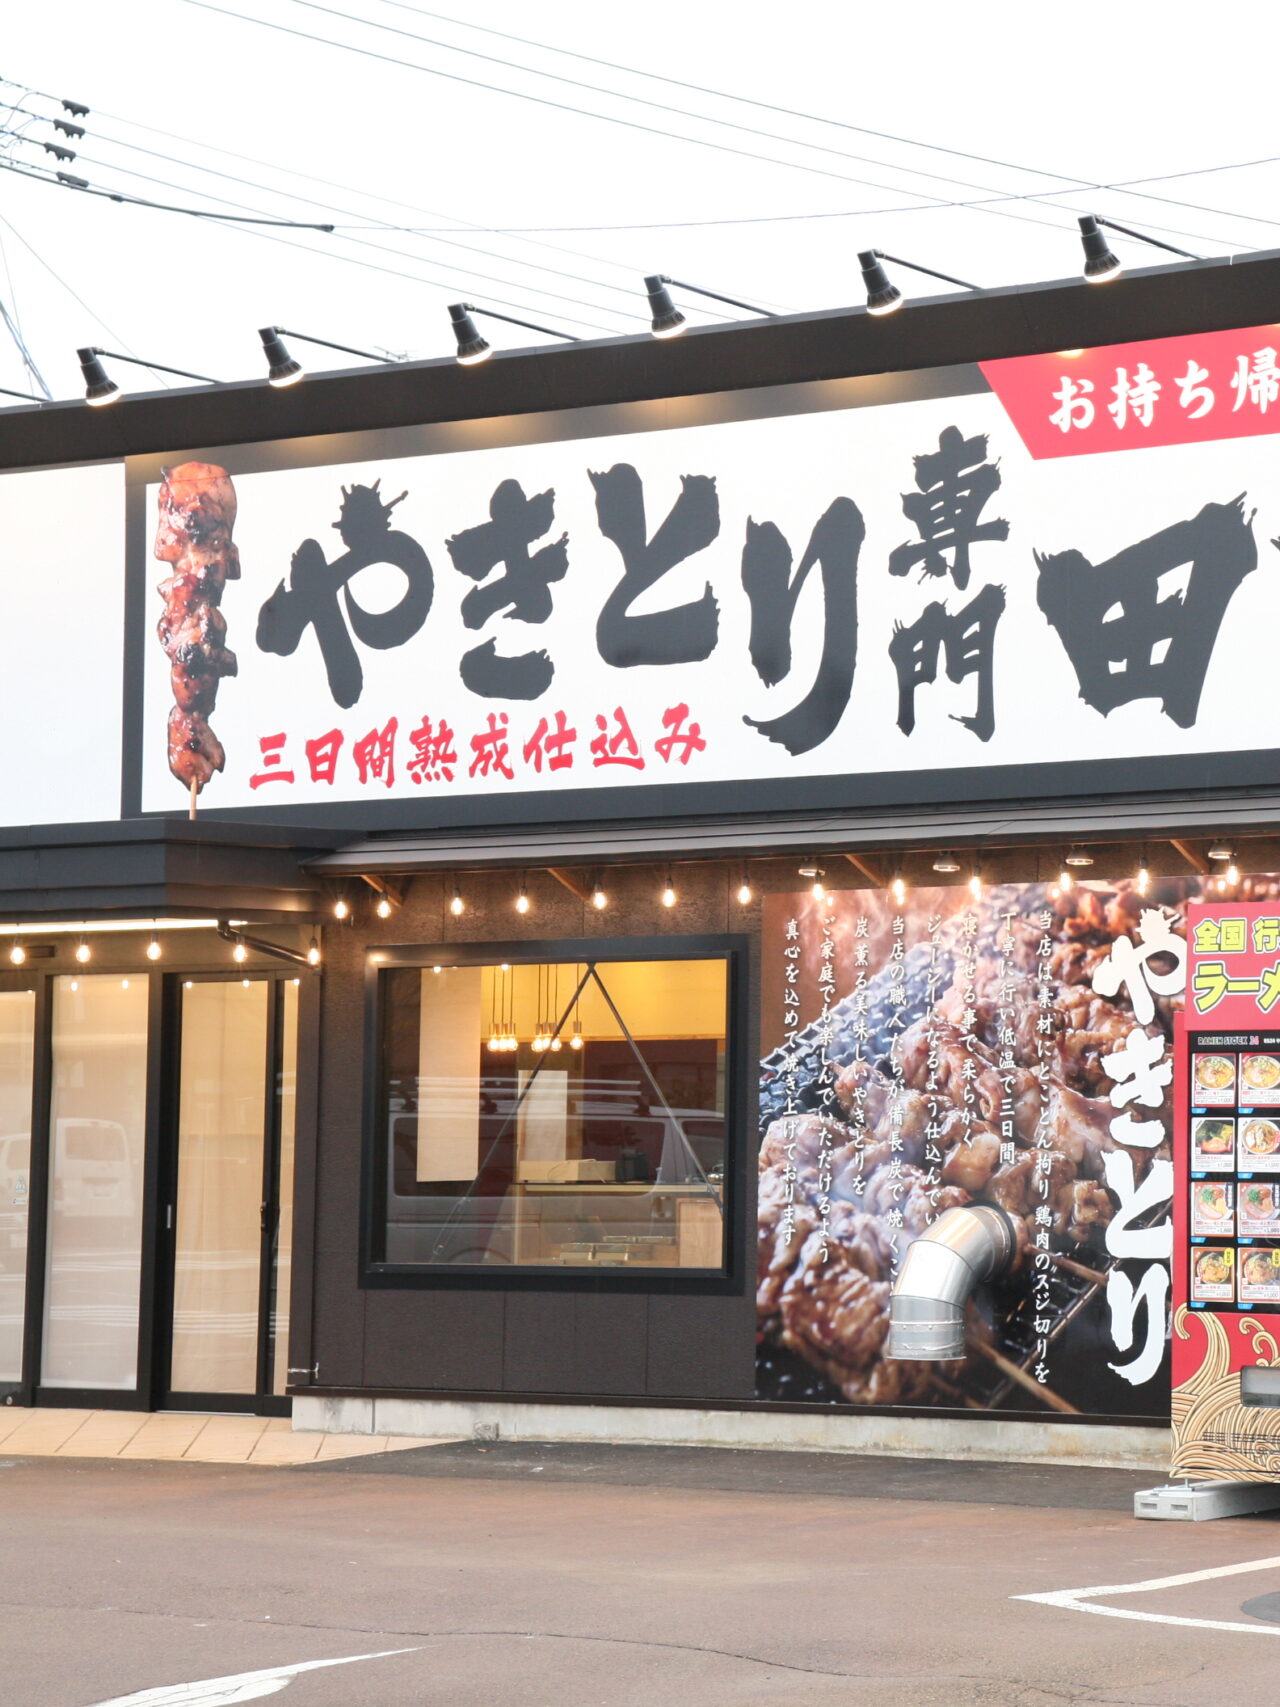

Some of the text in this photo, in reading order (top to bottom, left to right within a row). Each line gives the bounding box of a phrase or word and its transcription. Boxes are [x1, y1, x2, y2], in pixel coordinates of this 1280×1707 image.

[255, 462, 866, 757] やきとり
[888, 424, 1010, 742] 専門
[248, 702, 708, 790] 三日間熟成仕込み
[781, 918, 801, 1246] 真心を込めて焼き上げております
[851, 915, 871, 1196] 炭薫る美味しいやきとりを
[961, 912, 979, 1150] 寝かせる事で柔らかく
[998, 911, 1017, 1165] 丁寧に行い低温で三日間
[1193, 918, 1247, 954] 全国
[816, 914, 837, 1264] ご家庭でも楽しんでいただけるよう
[885, 915, 906, 1297] 当店の職人たちが備長炭で焼くこ
[1092, 908, 1188, 1387] やきとり
